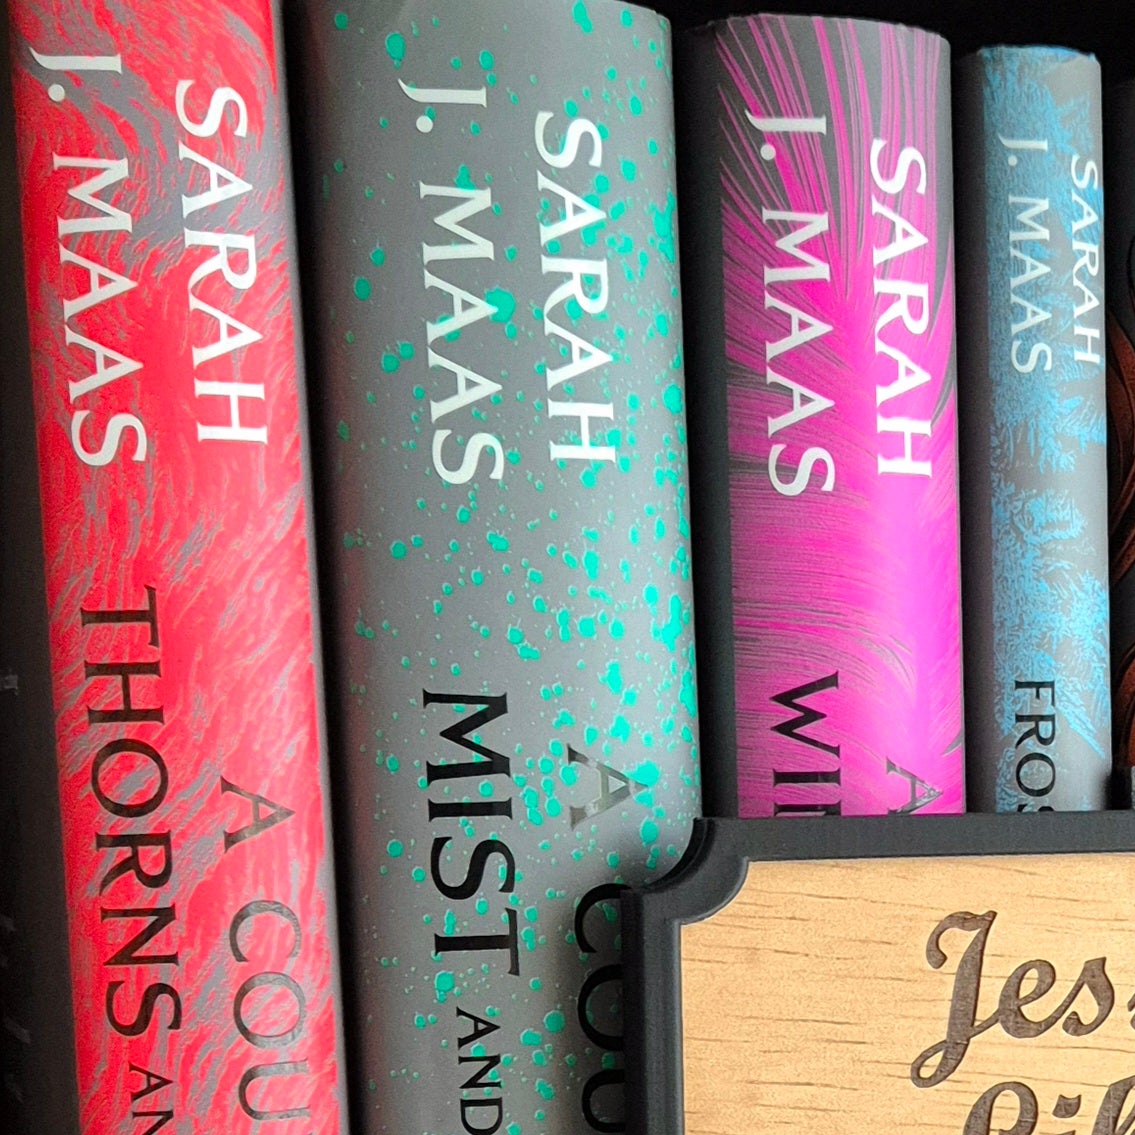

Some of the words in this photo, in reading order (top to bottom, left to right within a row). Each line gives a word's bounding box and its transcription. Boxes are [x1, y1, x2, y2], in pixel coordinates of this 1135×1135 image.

[29, 47, 122, 102] J.
[398, 78, 487, 134] J.
[744, 108, 826, 161] J.
[998, 132, 1047, 166] J.
[52, 152, 147, 467] MAAS
[176, 79, 268, 444] SARAH
[419, 180, 504, 485] MAAS
[534, 110, 617, 463] SARAH
[761, 207, 835, 497] MAAS
[870, 138, 933, 479] SARAH
[1007, 195, 1052, 373] MAAS
[1071, 155, 1102, 364] SARAH
[80, 584, 182, 1037] THORNS
[220, 776, 295, 852] A
[422, 688, 520, 975] MIST
[567, 743, 652, 830] A
[886, 755, 943, 813] A
[1014, 680, 1057, 812] FRO
